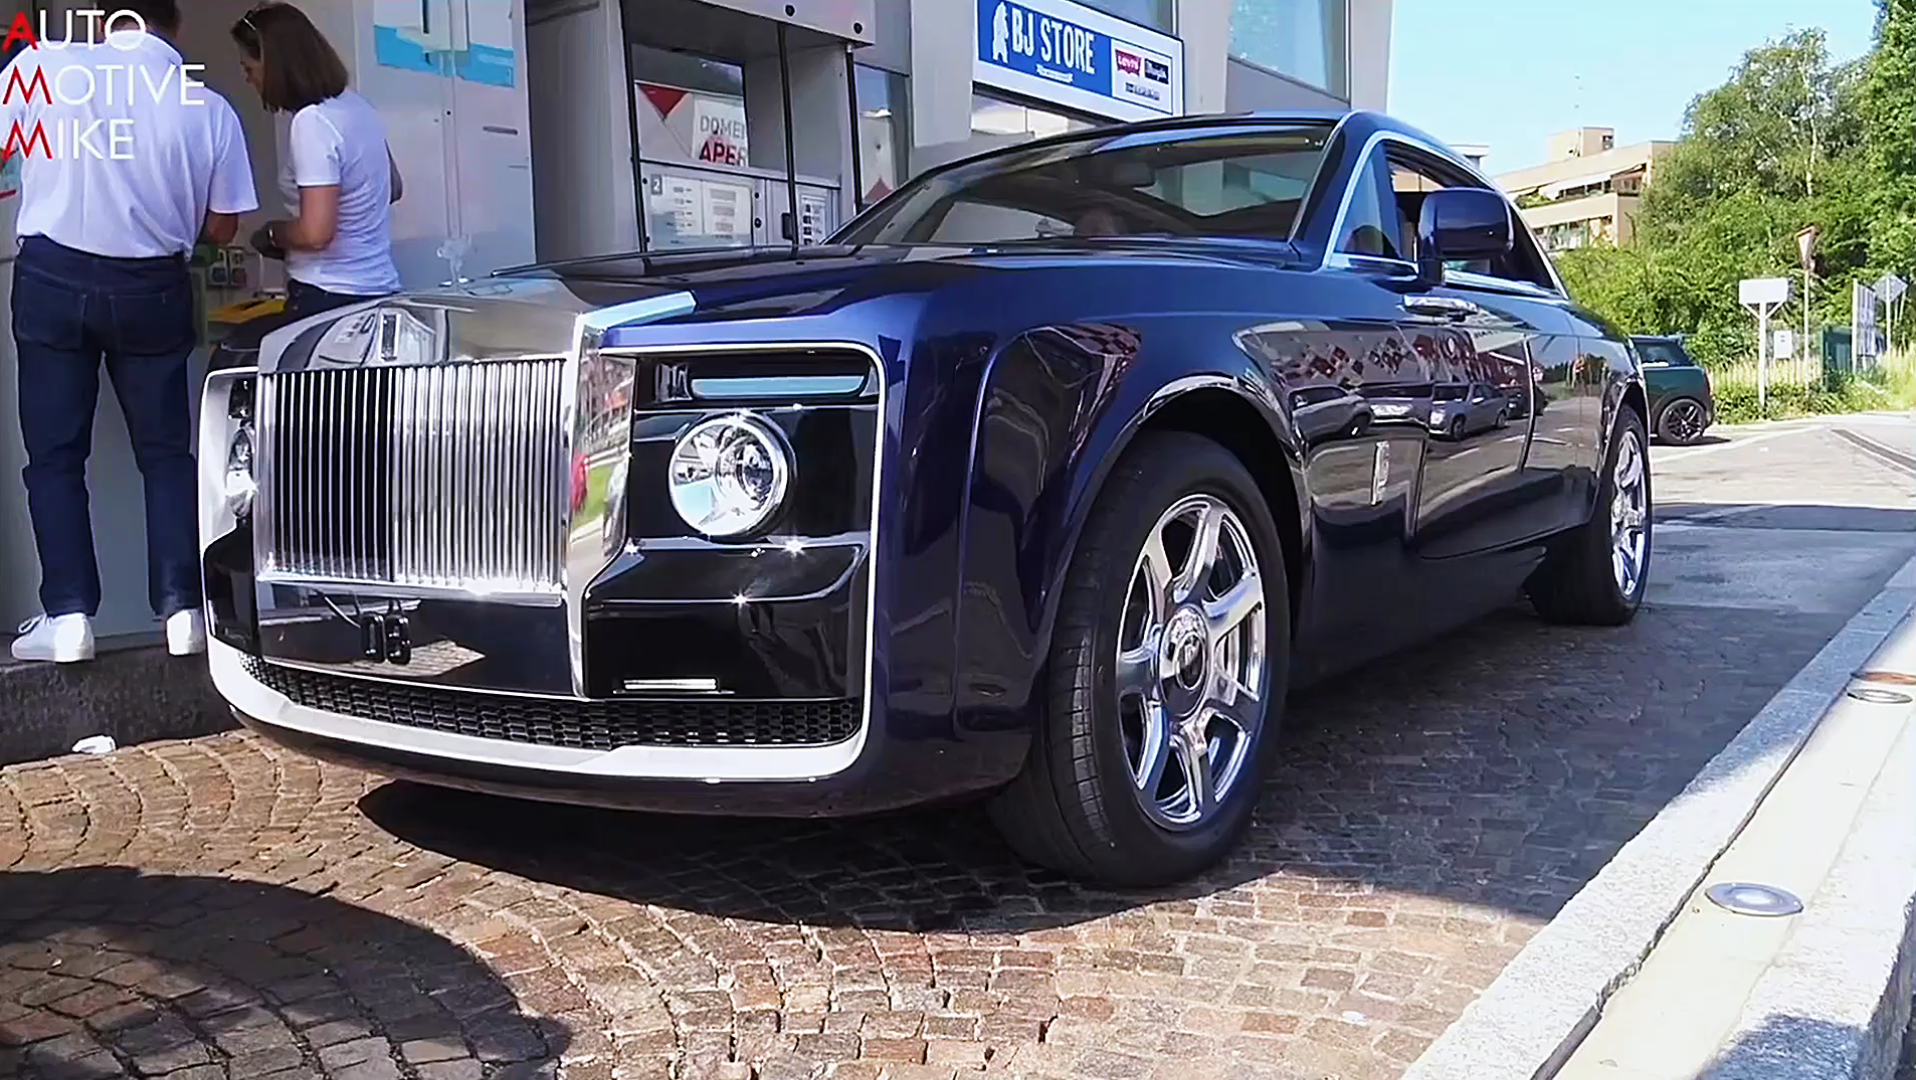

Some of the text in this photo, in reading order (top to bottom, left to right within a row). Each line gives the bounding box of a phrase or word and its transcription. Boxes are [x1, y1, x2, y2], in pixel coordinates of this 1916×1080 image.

[1012, 9, 1034, 56] BJ
[1041, 19, 1095, 74] STORE
[652, 178, 661, 192] 2
